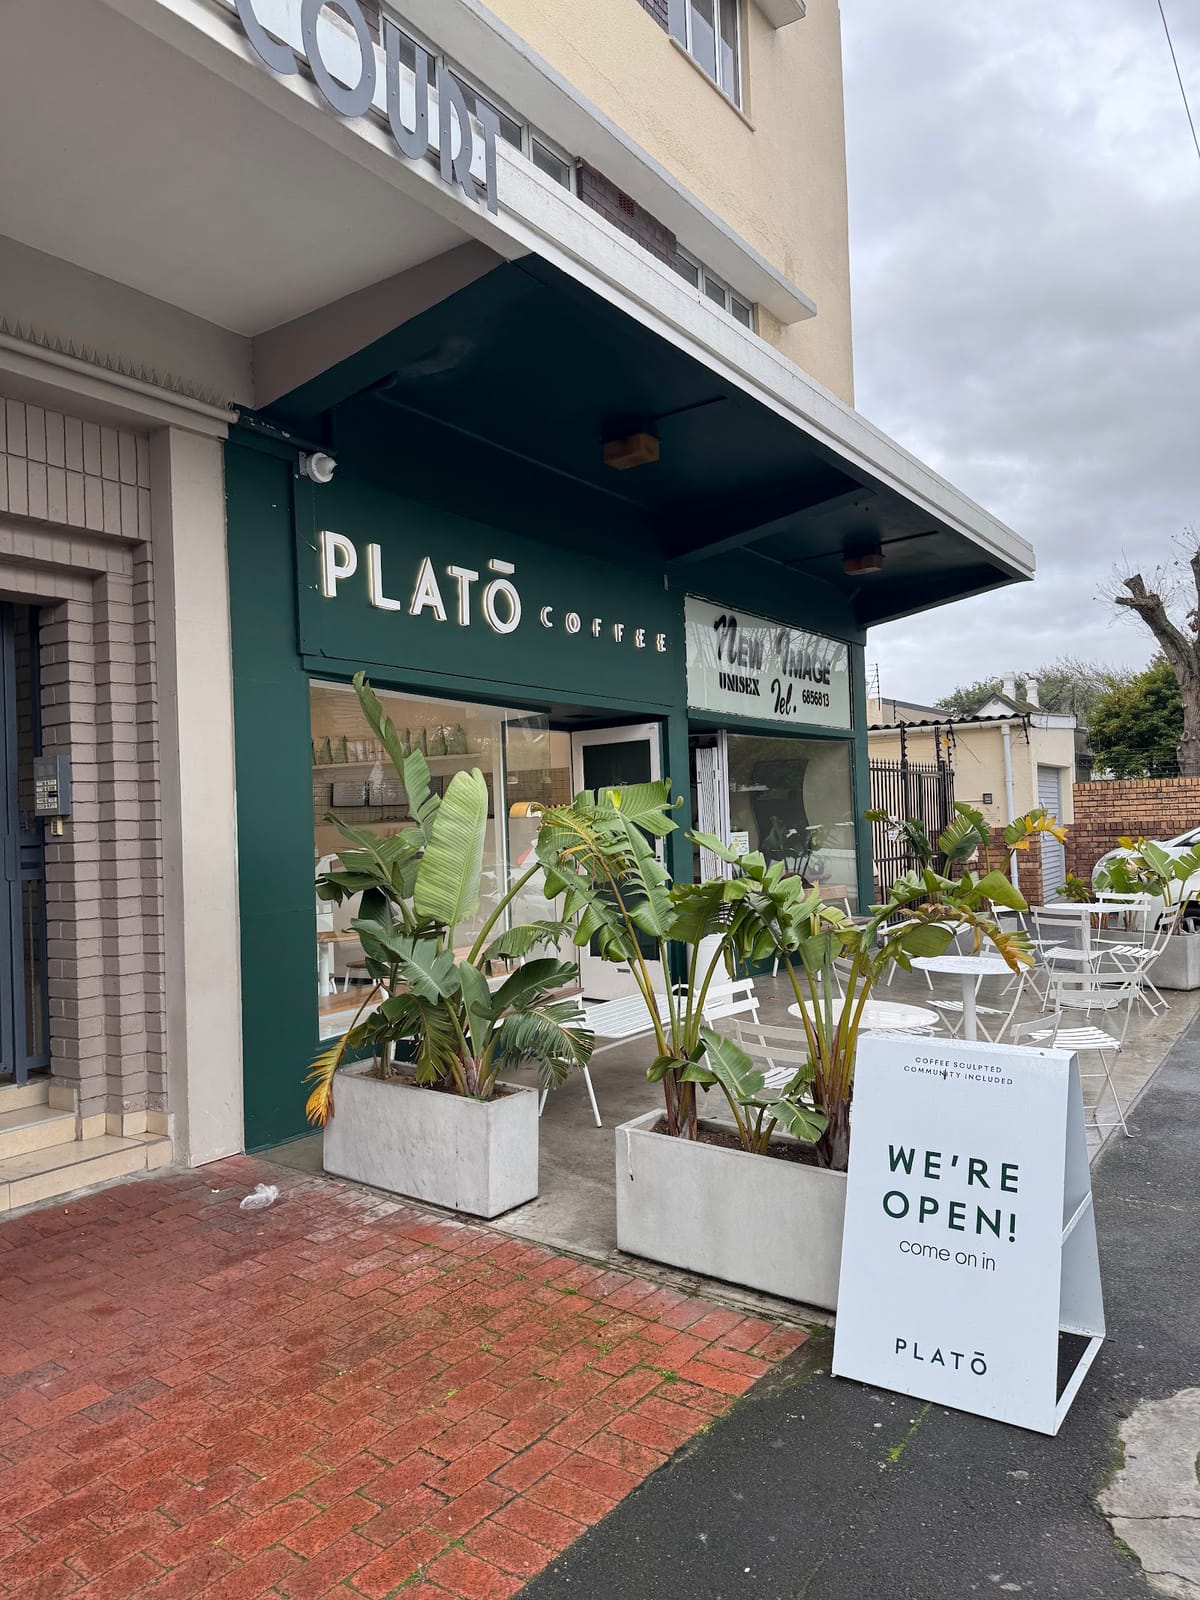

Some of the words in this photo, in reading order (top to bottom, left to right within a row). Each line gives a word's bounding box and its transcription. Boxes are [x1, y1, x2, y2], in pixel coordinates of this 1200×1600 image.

[540, 606, 667, 653] COFFEE
[718, 671, 761, 697] UNISEX
[770, 678, 797, 716] Tel.
[914, 1056, 950, 1068] COFFEE
[953, 1061, 1002, 1074] SCULPTED
[964, 1073, 1013, 1086] INCLUDED
[888, 1144, 1019, 1194] WE'RE
[882, 1190, 1017, 1243] OPEN!
[899, 1240, 951, 1262] come
[954, 1251, 978, 1268] on
[982, 1252, 996, 1272] in
